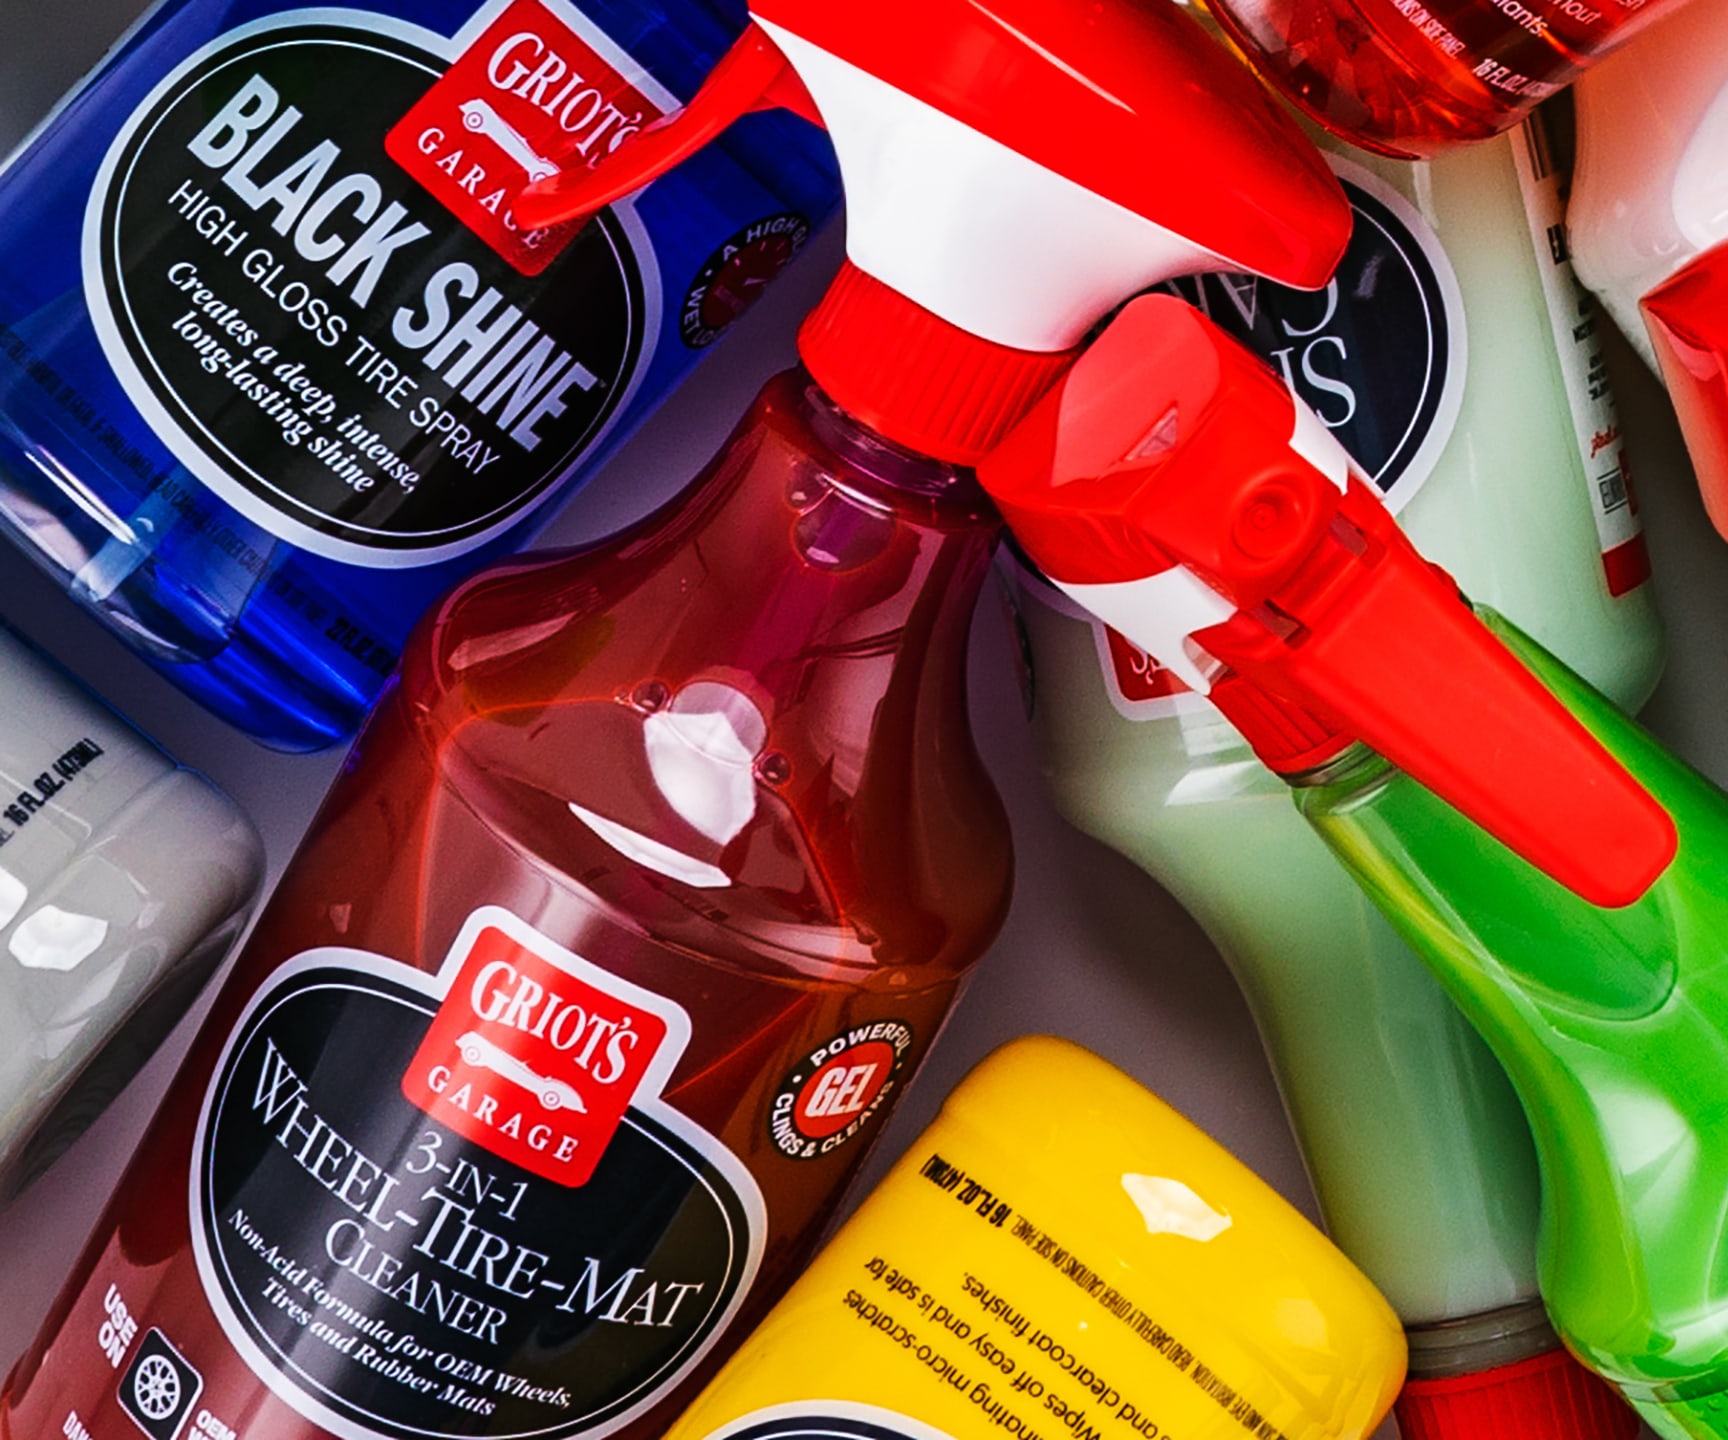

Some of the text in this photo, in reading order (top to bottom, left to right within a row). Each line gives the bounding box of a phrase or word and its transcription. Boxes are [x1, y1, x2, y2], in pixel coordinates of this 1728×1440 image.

[187, 73, 598, 451] BLACK SHINE
[168, 180, 501, 476] HIGH GLOSS TIRE SPRAY
[168, 262, 421, 494] Creates a deep, intense,
[172, 312, 376, 492] long-lasting shine
[470, 961, 639, 1084] GRIOT'S
[810, 1022, 910, 1057] POWERFUL
[427, 1066, 578, 1163] GARAGE
[772, 1081, 894, 1155] CLINGS CLEANS
[805, 1063, 878, 1117] GEL
[250, 1036, 704, 1328] WHEEL-TIRE-MAT
[405, 1131, 529, 1221] 3-IN-1
[989, 1203, 1013, 1228] 16
[104, 1283, 138, 1347] USE
[227, 1208, 572, 1410] Non-Acid Formula for OEM Wheels,
[325, 1219, 509, 1344] CLEANER
[843, 1289, 972, 1393] micro-scratches
[99, 1321, 127, 1369] ON
[260, 1278, 497, 1417] Tires and Rubber Mats
[864, 1256, 1103, 1440] Wipes off easy and is safe for
[961, 1271, 1159, 1440] and clearcoat finishes.
